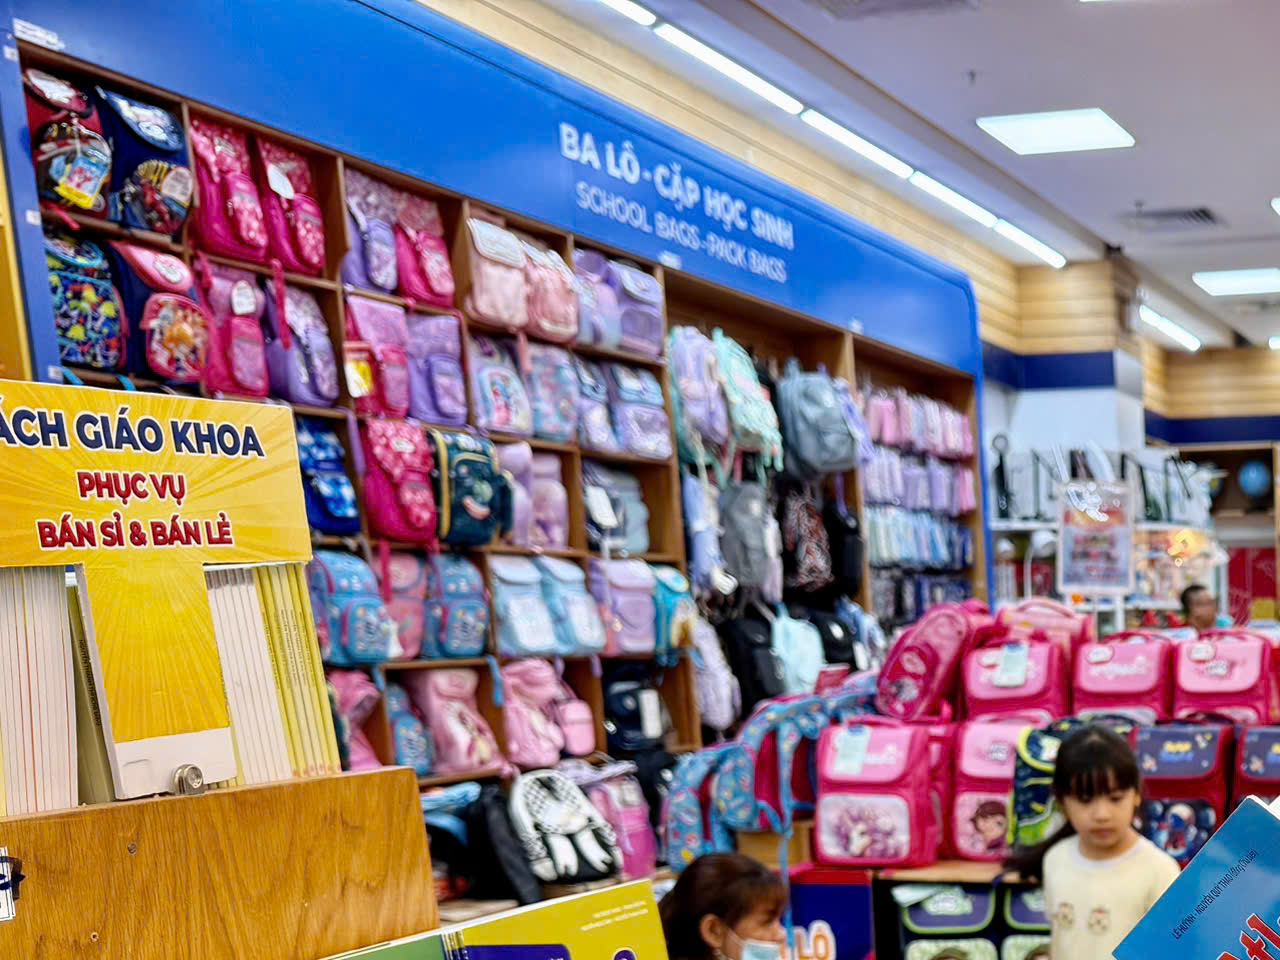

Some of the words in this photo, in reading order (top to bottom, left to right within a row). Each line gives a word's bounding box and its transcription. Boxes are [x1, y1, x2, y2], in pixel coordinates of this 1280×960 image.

[560, 122, 600, 169] BA
[605, 140, 640, 184] LÔ
[653, 162, 700, 212] CẶP
[703, 185, 747, 232] HỌC
[751, 207, 794, 250] SINH
[576, 181, 653, 232] SCHOOL
[76, 407, 163, 452] GIÁO
[171, 421, 264, 456] KHOA
[77, 472, 148, 504] PHỤC
[151, 474, 186, 505] VỤ
[37, 514, 96, 547] BÁN
[100, 512, 124, 546] SỈ
[130, 522, 146, 546] &
[151, 515, 201, 545] BÁN
[205, 513, 233, 544] LẺ
